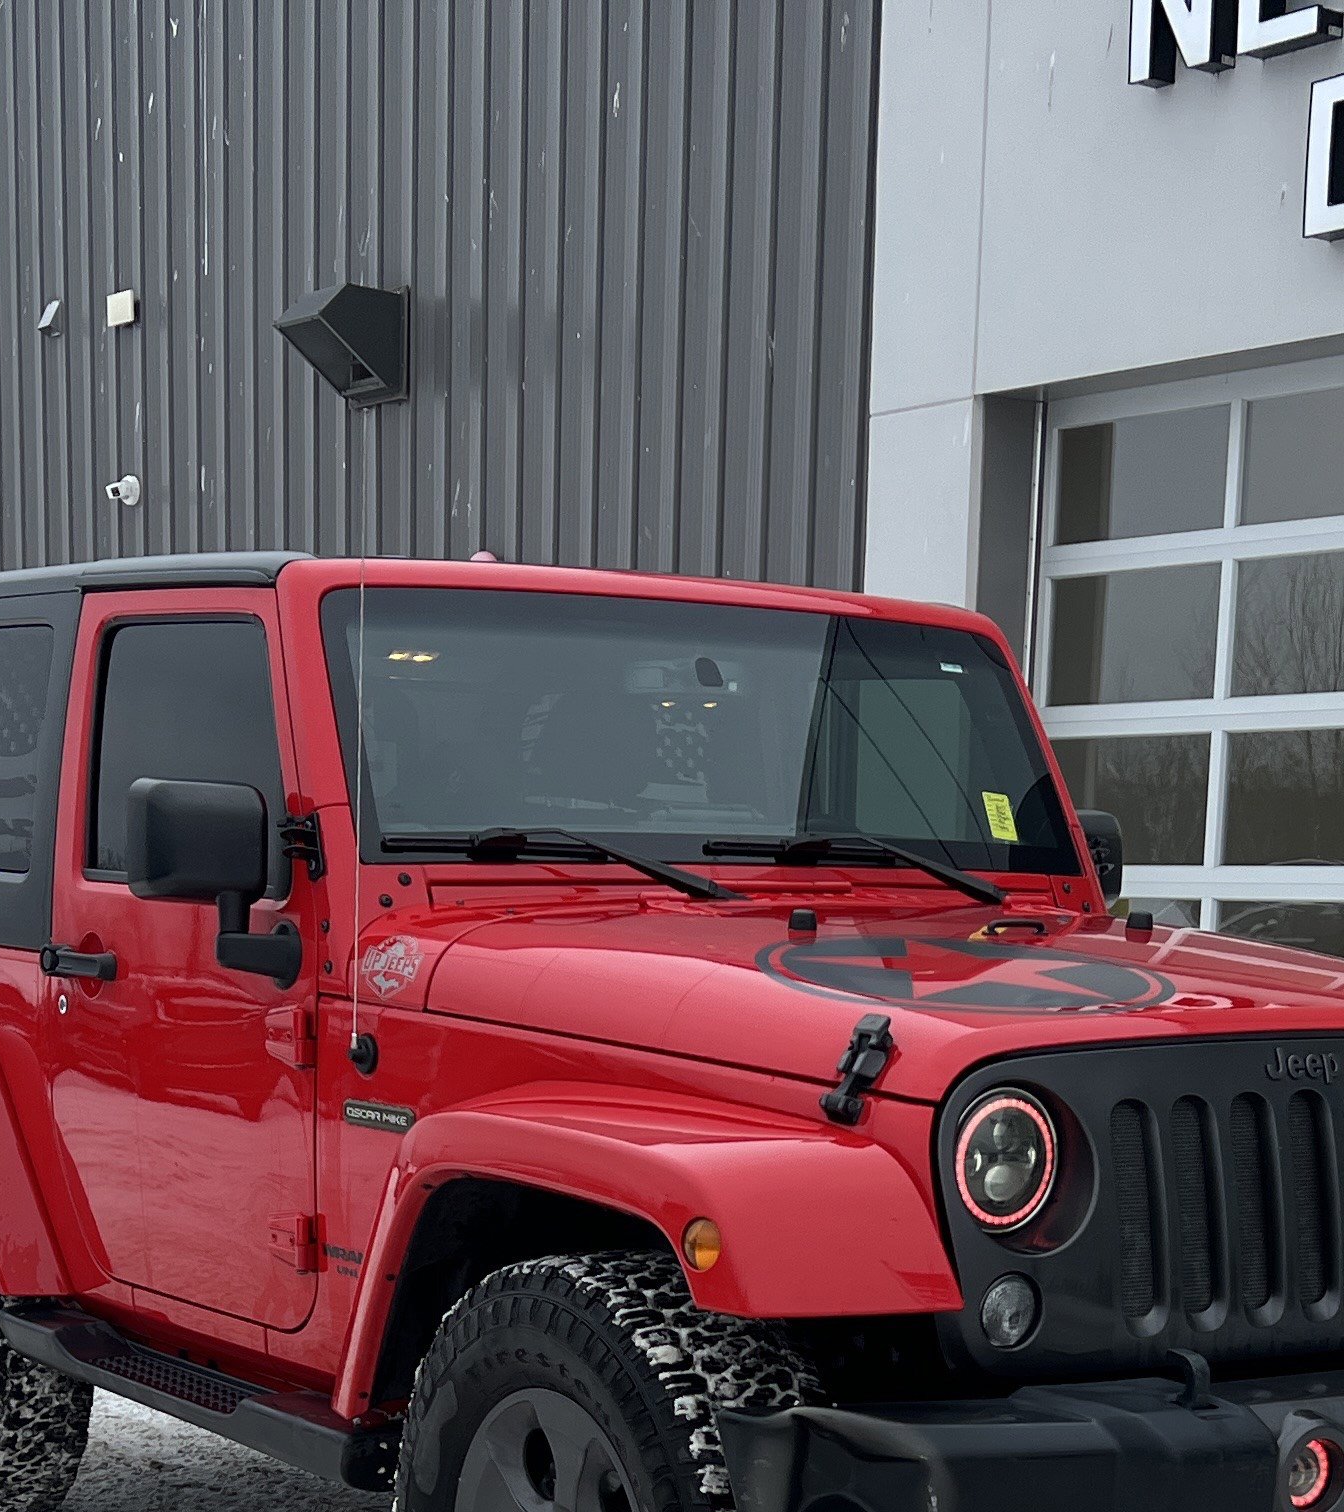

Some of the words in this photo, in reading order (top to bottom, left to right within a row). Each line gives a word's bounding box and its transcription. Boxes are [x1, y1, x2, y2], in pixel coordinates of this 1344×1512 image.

[1265, 1047, 1339, 1083] Jeep
[346, 1106, 381, 1121] OSCAR
[382, 1112, 408, 1126] MIKE
